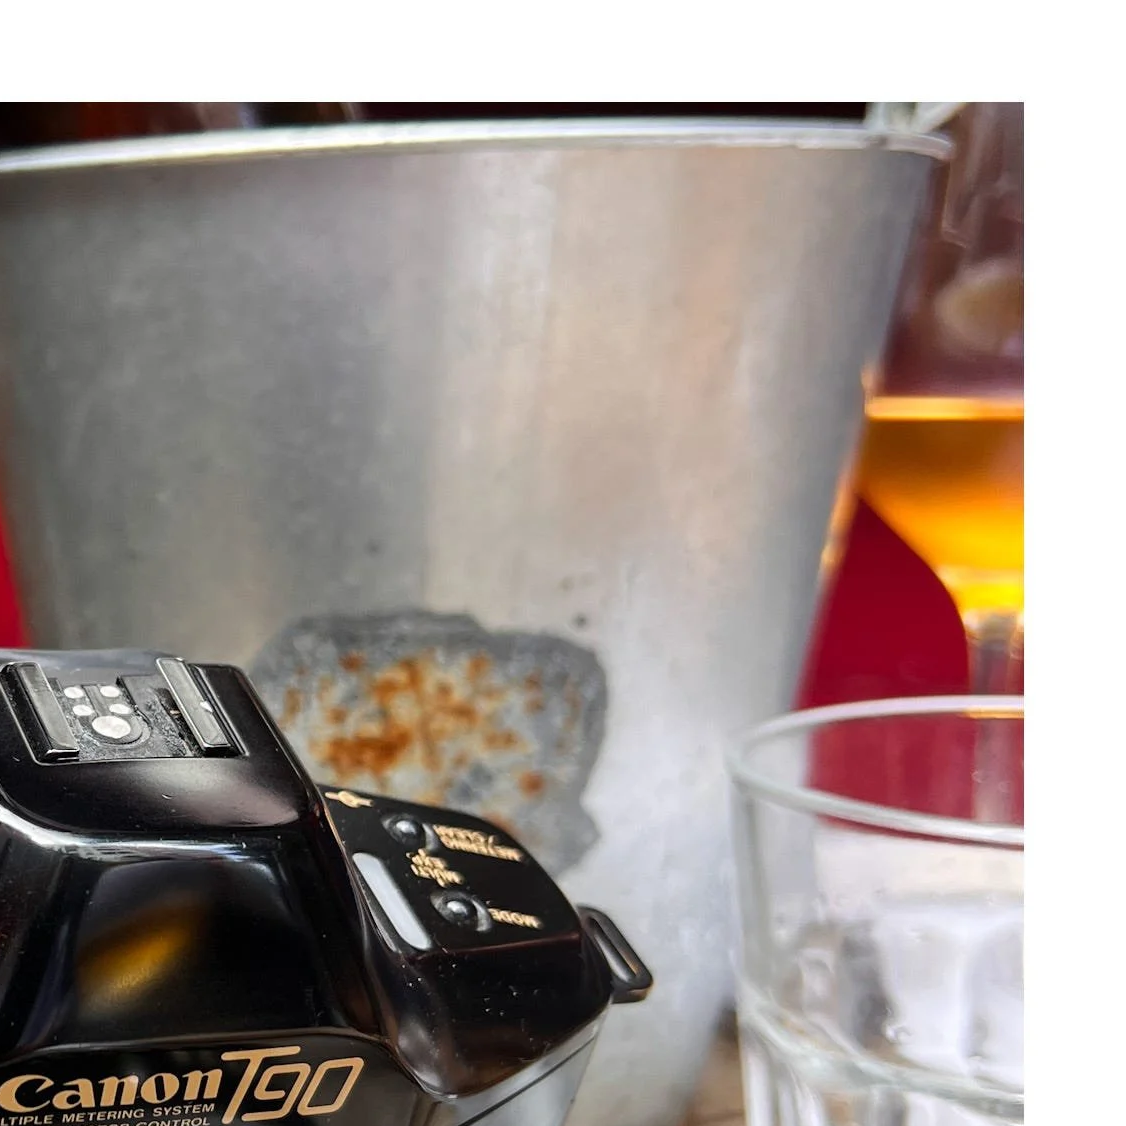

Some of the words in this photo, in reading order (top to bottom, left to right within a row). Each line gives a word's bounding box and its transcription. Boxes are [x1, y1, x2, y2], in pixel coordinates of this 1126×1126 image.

[487, 907, 543, 930] MODE
[220, 1046, 365, 1125] T90
[61, 1106, 145, 1123] METERING
[152, 1102, 216, 1116] SYSTEM
